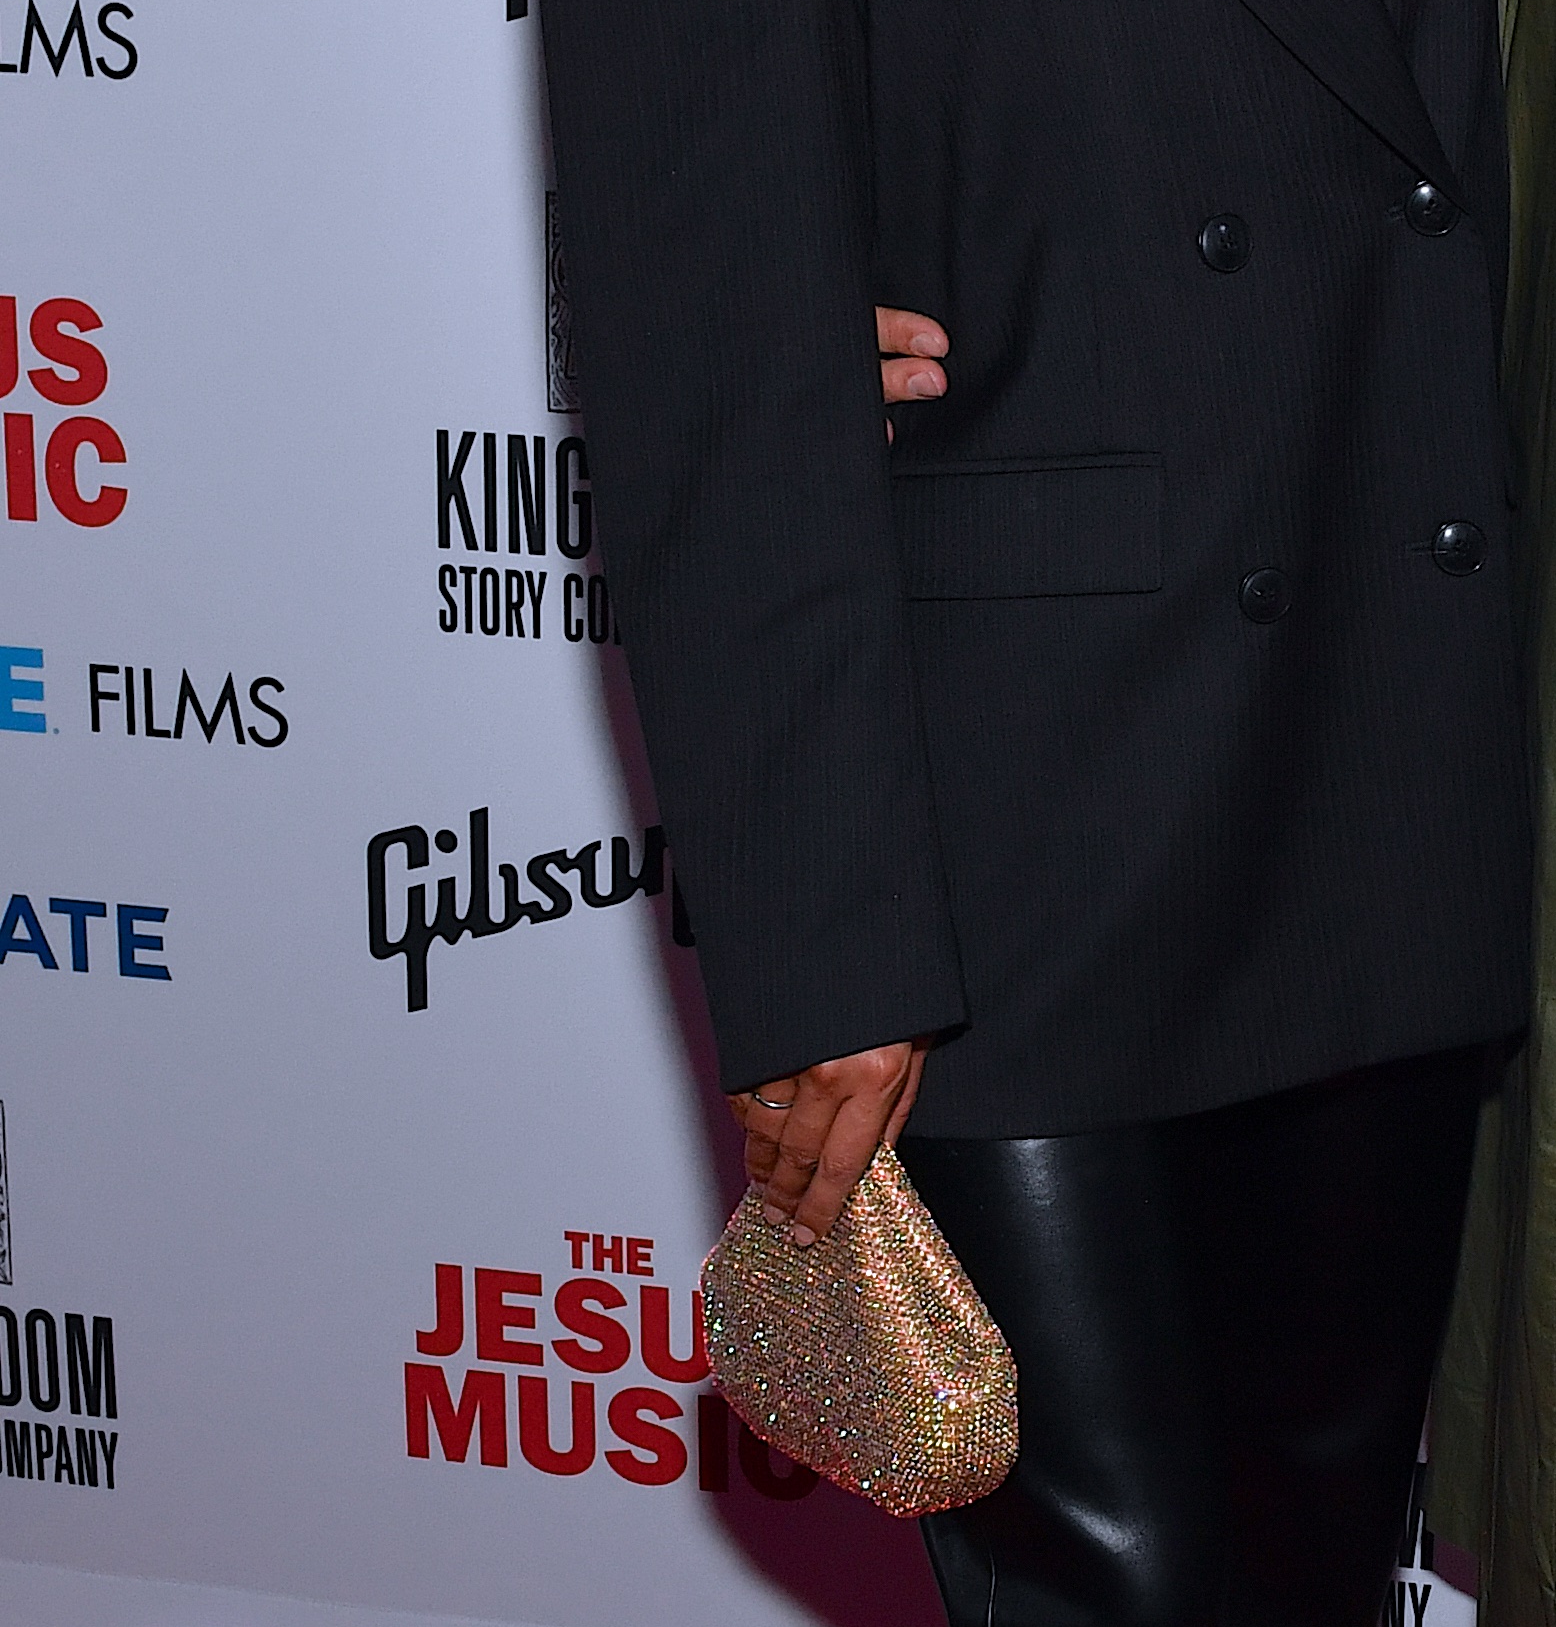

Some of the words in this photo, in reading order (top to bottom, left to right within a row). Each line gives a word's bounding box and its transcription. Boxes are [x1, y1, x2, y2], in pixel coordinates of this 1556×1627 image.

[438, 563, 547, 640] STORY
[563, 573, 621, 646] CO
[89, 663, 289, 748] FILMS
[564, 1230, 655, 1278] THE
[0, 1419, 118, 1490] MPANY
